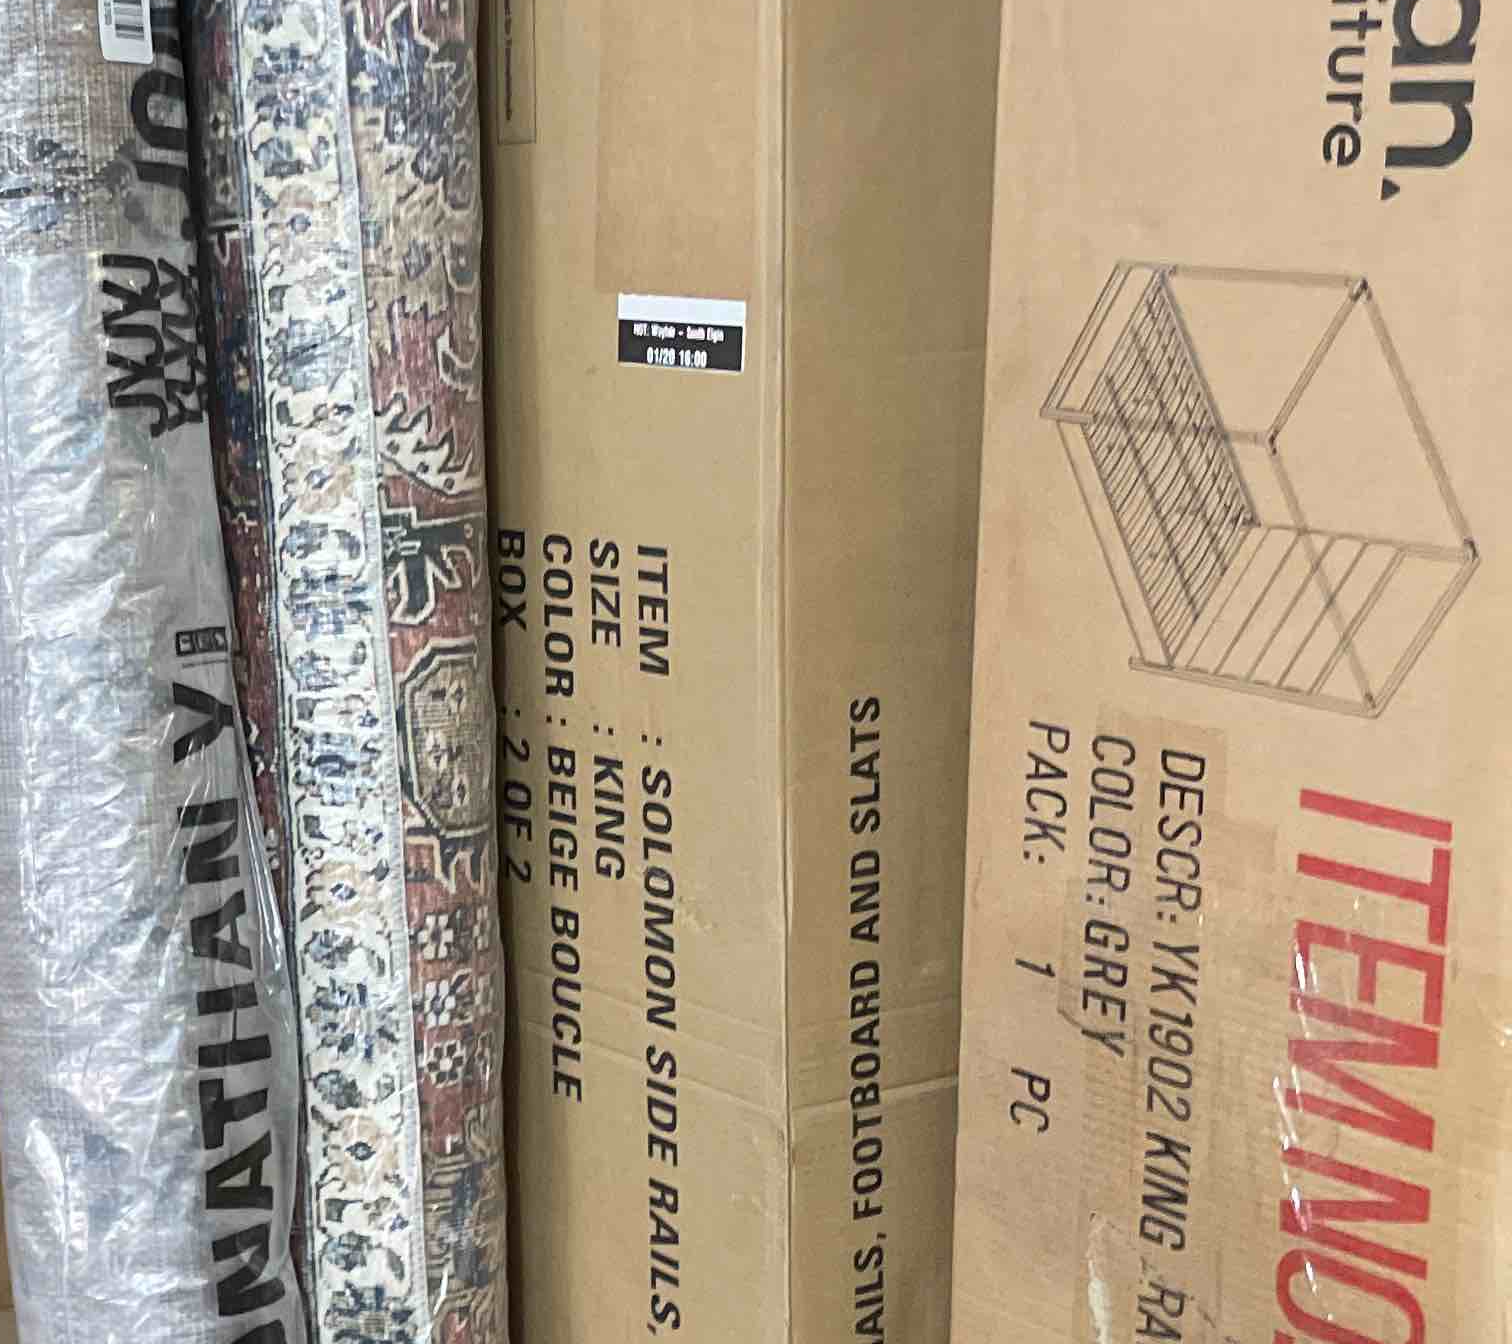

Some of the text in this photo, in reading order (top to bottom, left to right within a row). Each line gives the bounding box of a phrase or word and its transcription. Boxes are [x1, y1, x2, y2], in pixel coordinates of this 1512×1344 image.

[497, 529, 528, 632] BOX
[542, 532, 576, 698] COLOR
[589, 537, 622, 649] SIZE
[636, 544, 671, 677] ITEM
[502, 736, 532, 763] 2
[503, 782, 533, 843] OF
[547, 747, 578, 892] BEIGE
[592, 754, 626, 882] KING
[849, 693, 881, 833] SLATS
[505, 860, 533, 886] 2
[640, 765, 678, 1032] SOLOMON
[850, 847, 881, 946] AND
[1154, 747, 1207, 925] DESCR:
[1008, 719, 1071, 1135] PACK: 1 PC
[1080, 917, 1131, 1059] GREY
[1287, 787, 1453, 1154] ITEM
[550, 905, 583, 1105] BOUCLE
[1144, 943, 1201, 1123] YK1902
[645, 1044, 680, 1167] SIDE
[849, 957, 884, 1220] FOOTBOARD
[646, 1179, 681, 1335] RAILS,
[1138, 1128, 1192, 1253] KING
